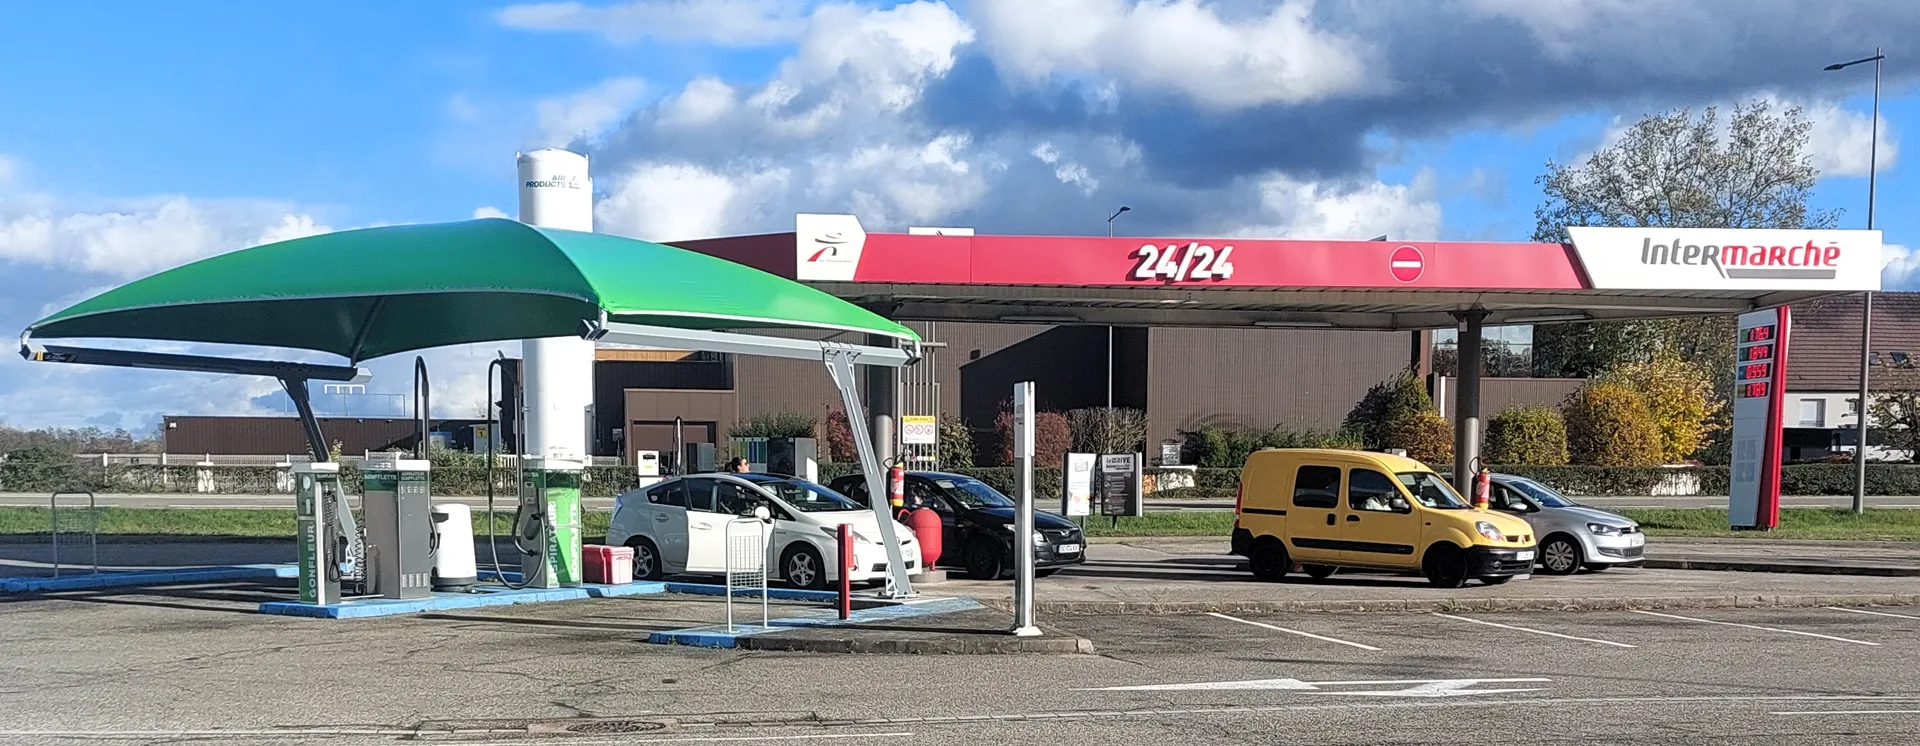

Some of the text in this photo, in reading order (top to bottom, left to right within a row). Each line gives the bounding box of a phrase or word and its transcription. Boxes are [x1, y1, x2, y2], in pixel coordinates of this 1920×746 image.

[1134, 241, 1234, 282] 24/24
[1641, 237, 1841, 279] Intermarché
[307, 525, 317, 598] GONFLEUR
[548, 501, 559, 582] SPIRATEUR
